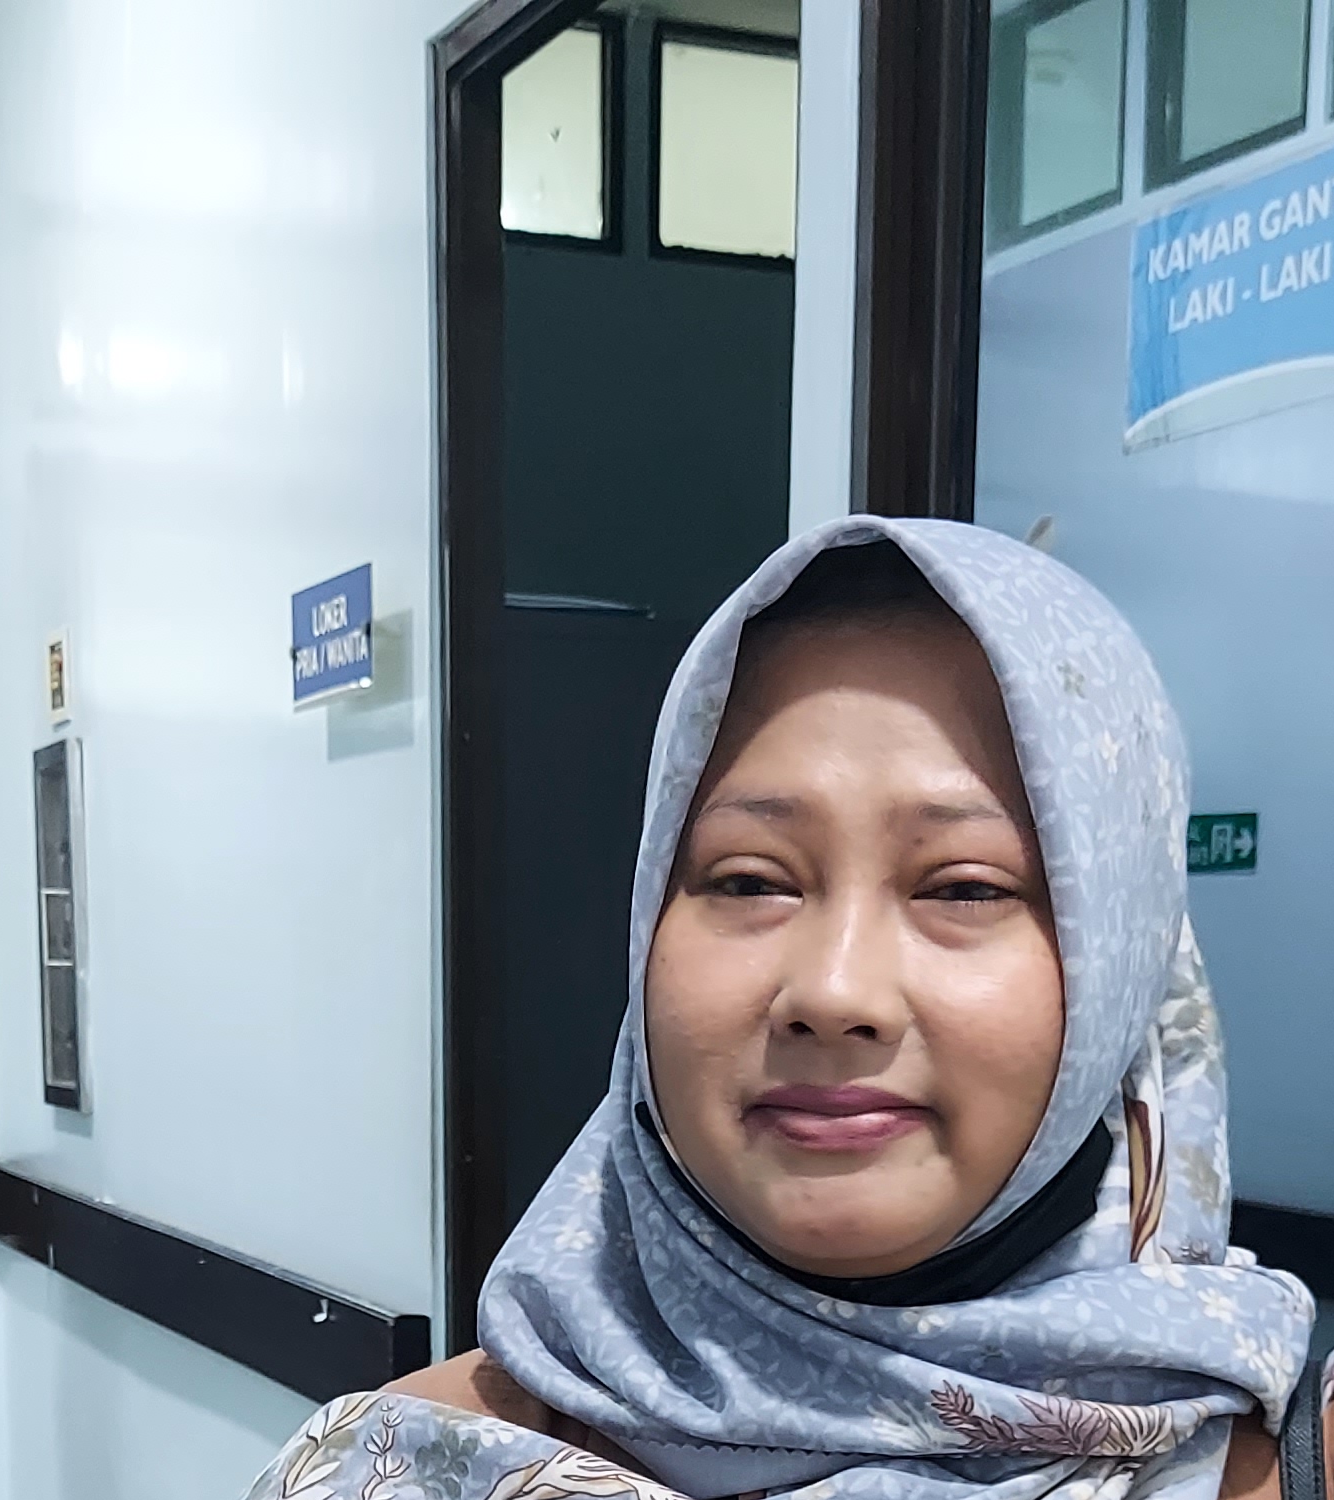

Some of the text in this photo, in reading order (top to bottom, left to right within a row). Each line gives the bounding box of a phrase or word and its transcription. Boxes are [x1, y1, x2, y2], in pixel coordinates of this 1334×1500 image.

[1148, 210, 1251, 284] KAMAR
[1168, 276, 1234, 334] LAKI
[1260, 240, 1332, 302] LAKI
